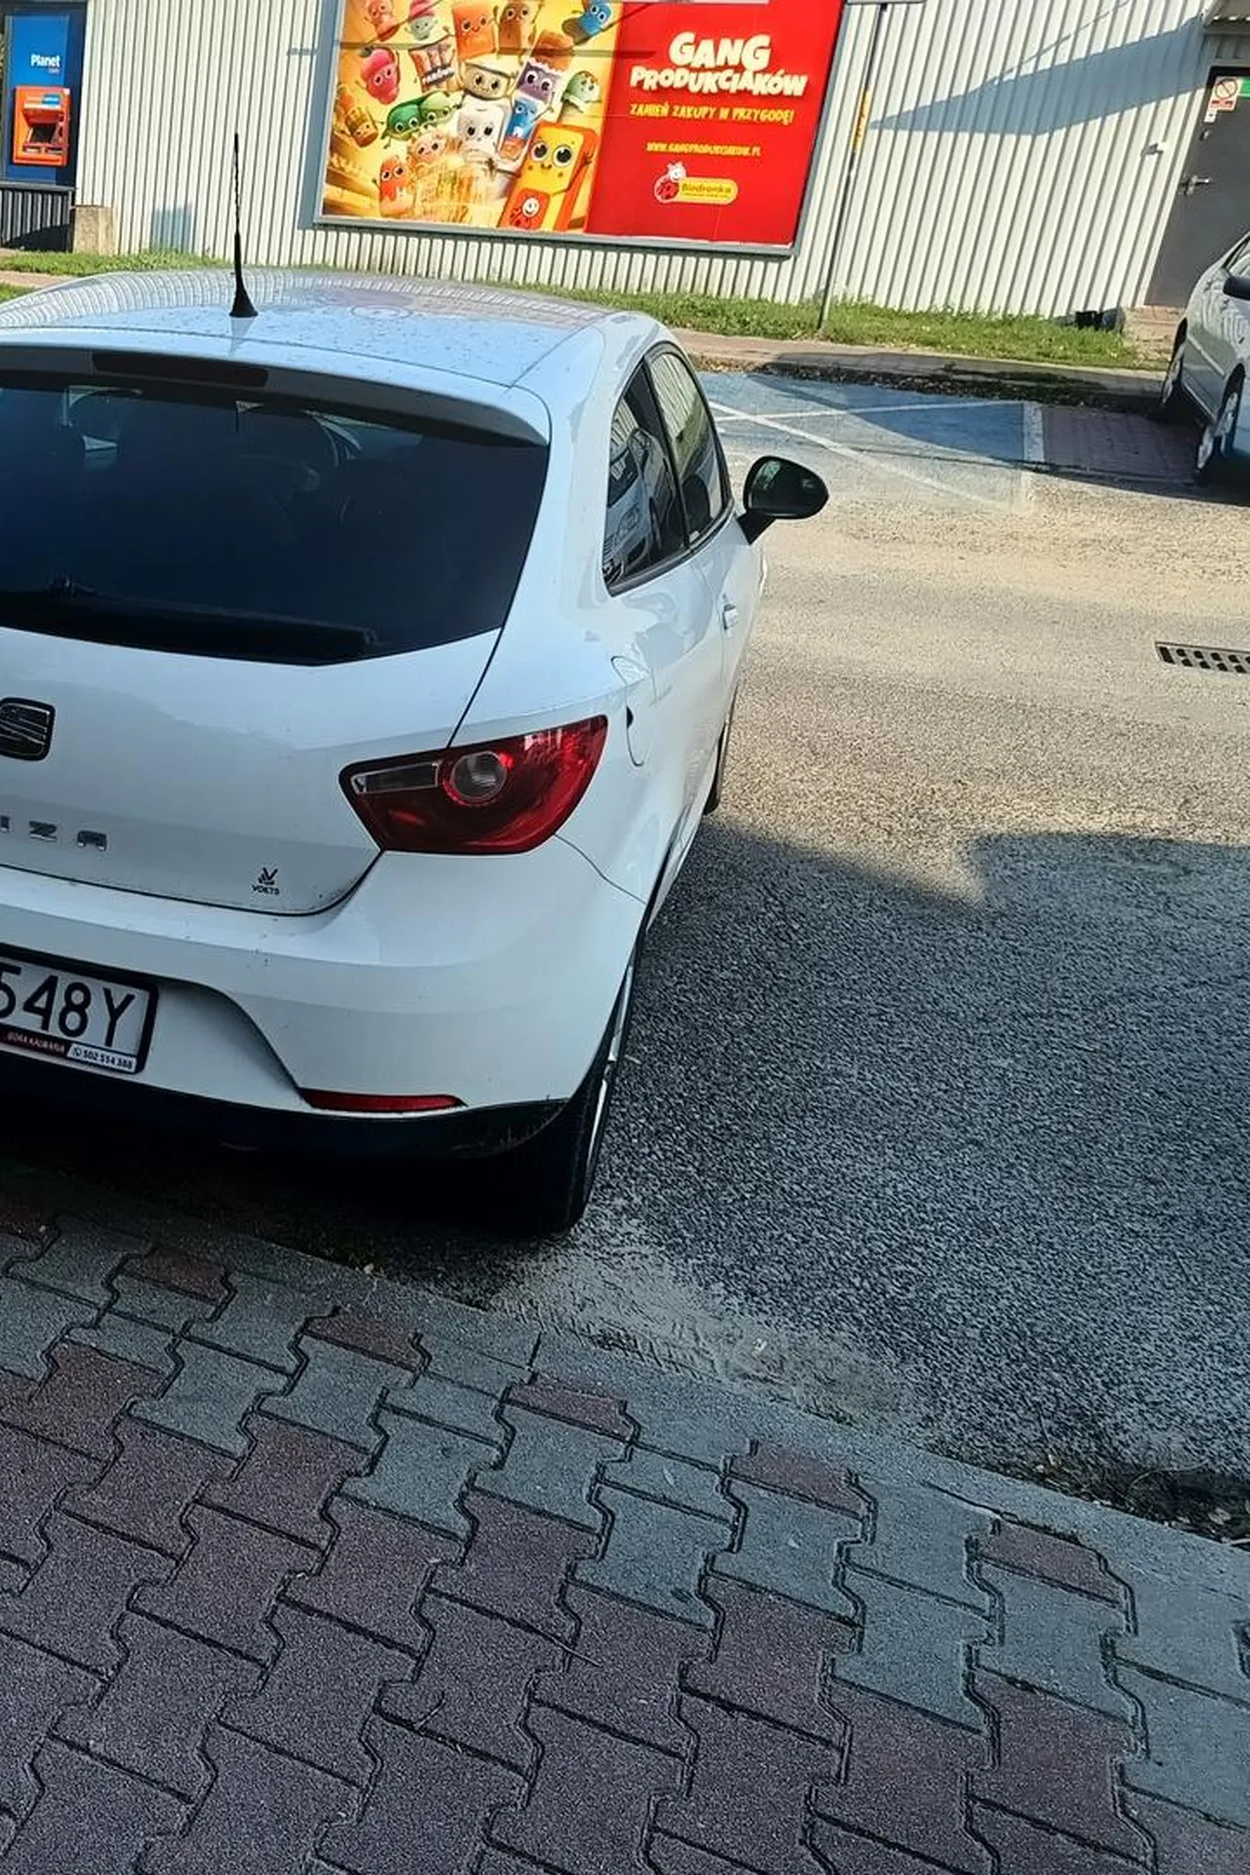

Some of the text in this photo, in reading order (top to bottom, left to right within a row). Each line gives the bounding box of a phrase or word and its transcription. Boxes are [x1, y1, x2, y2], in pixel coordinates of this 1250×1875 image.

[30, 54, 61, 68] Planet
[669, 31, 771, 71] GANG
[630, 66, 808, 96] PRODUKCIAKÓW
